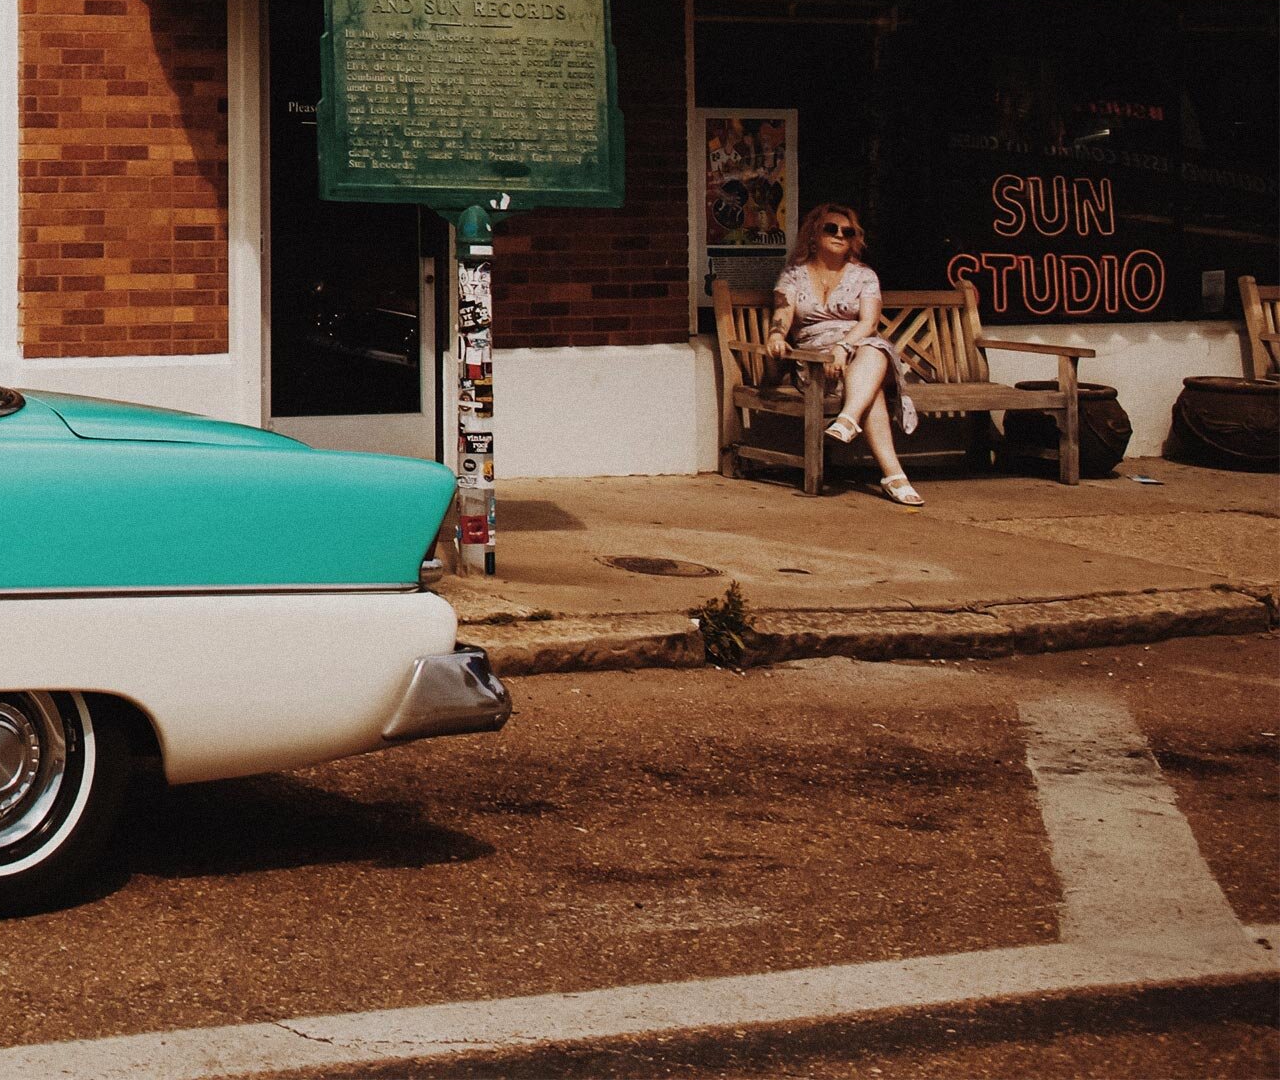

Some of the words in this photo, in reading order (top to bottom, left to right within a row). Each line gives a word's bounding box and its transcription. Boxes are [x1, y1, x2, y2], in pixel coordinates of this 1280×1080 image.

[424, 0, 462, 16] SUN
[473, 0, 567, 21] RECORDS
[346, 72, 396, 85] combining
[348, 160, 365, 169] Sun
[992, 174, 1115, 237] SUN
[947, 249, 1165, 315] STUDIO
